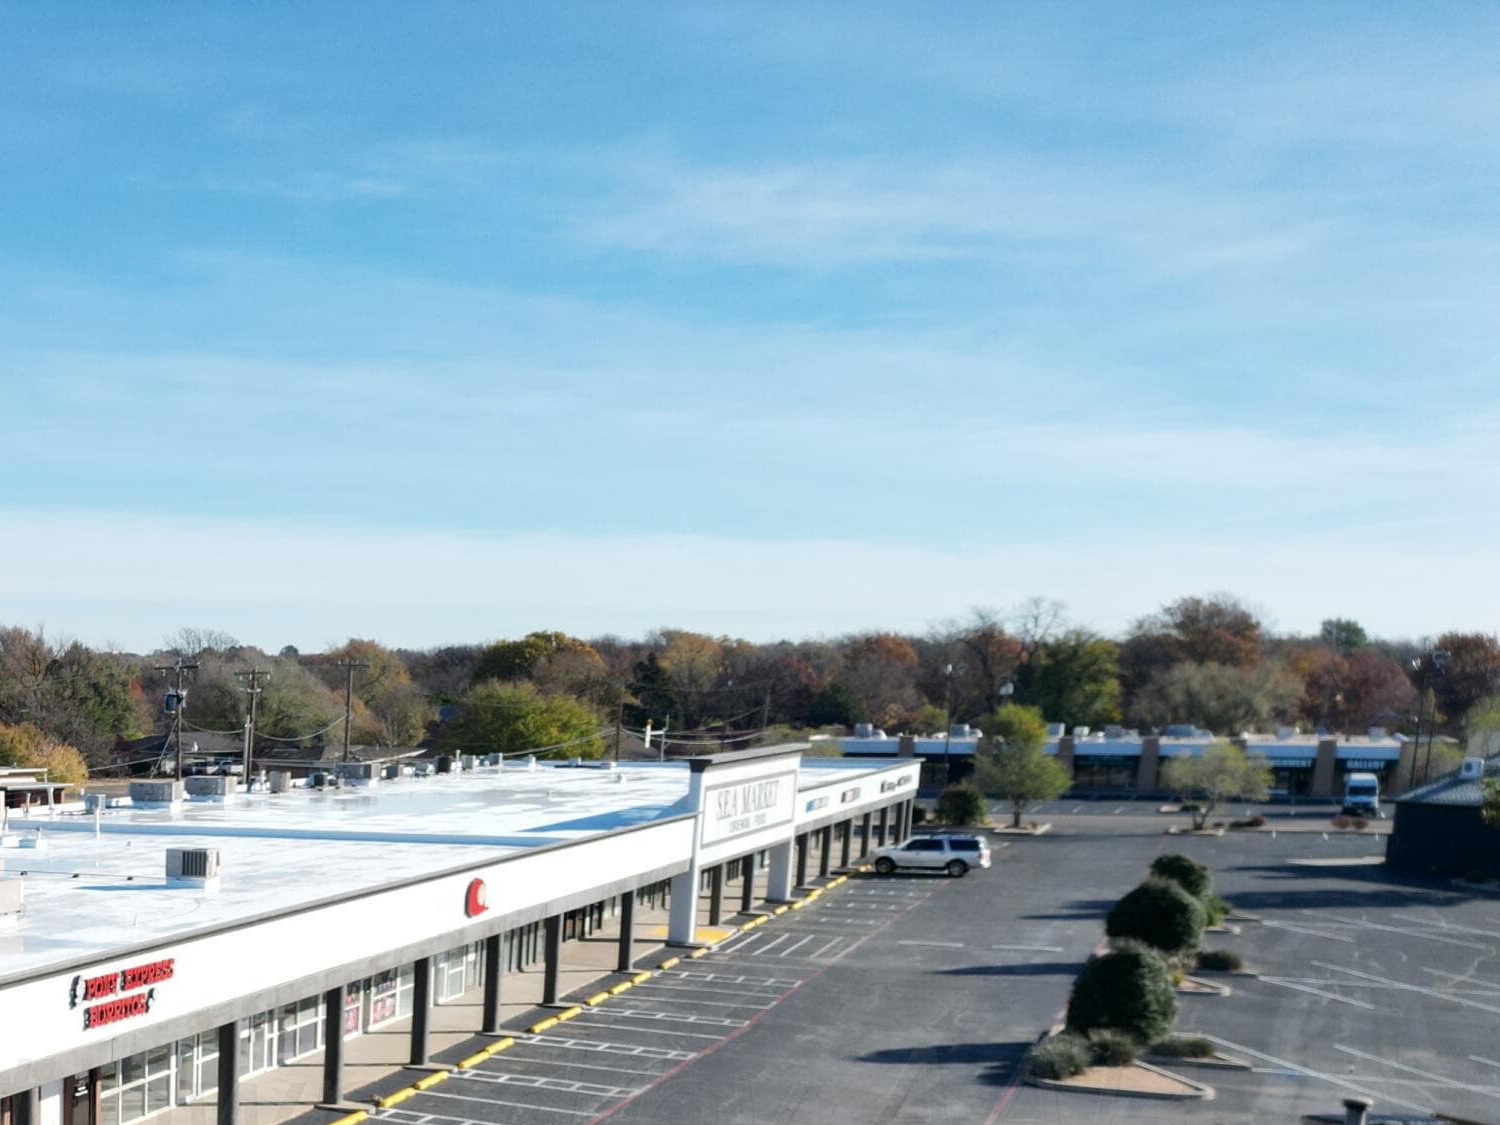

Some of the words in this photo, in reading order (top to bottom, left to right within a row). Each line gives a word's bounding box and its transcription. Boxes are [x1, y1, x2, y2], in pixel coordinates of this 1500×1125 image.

[83, 972, 120, 1001] PONY
[120, 958, 175, 991] EXPRESS
[83, 992, 147, 1031] BURRITOS
